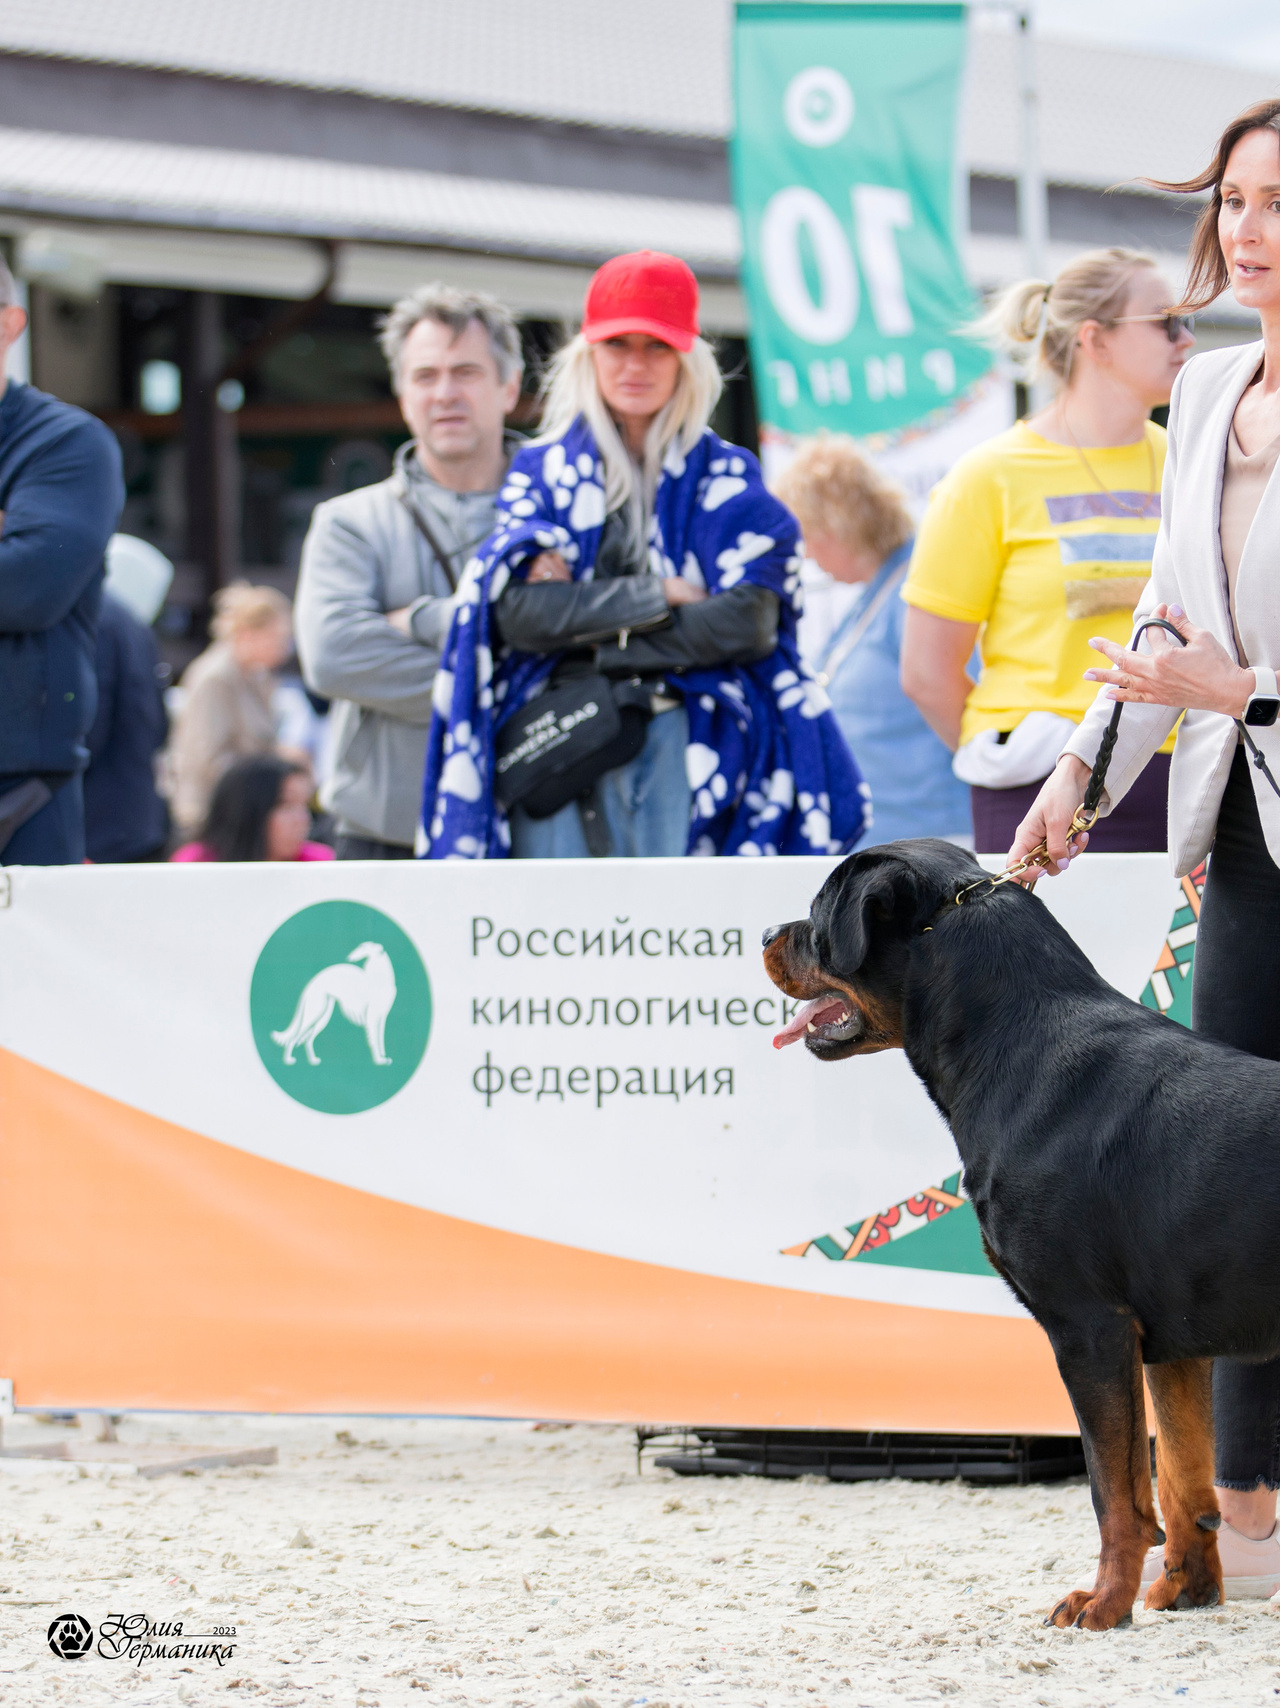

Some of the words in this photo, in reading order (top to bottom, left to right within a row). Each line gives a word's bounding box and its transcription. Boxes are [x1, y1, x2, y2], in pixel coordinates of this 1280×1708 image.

[559, 701, 599, 732] BAG
[471, 916, 744, 958] Российская
[471, 997, 800, 1027] кинологическ
[472, 1051, 735, 1108] федерация
